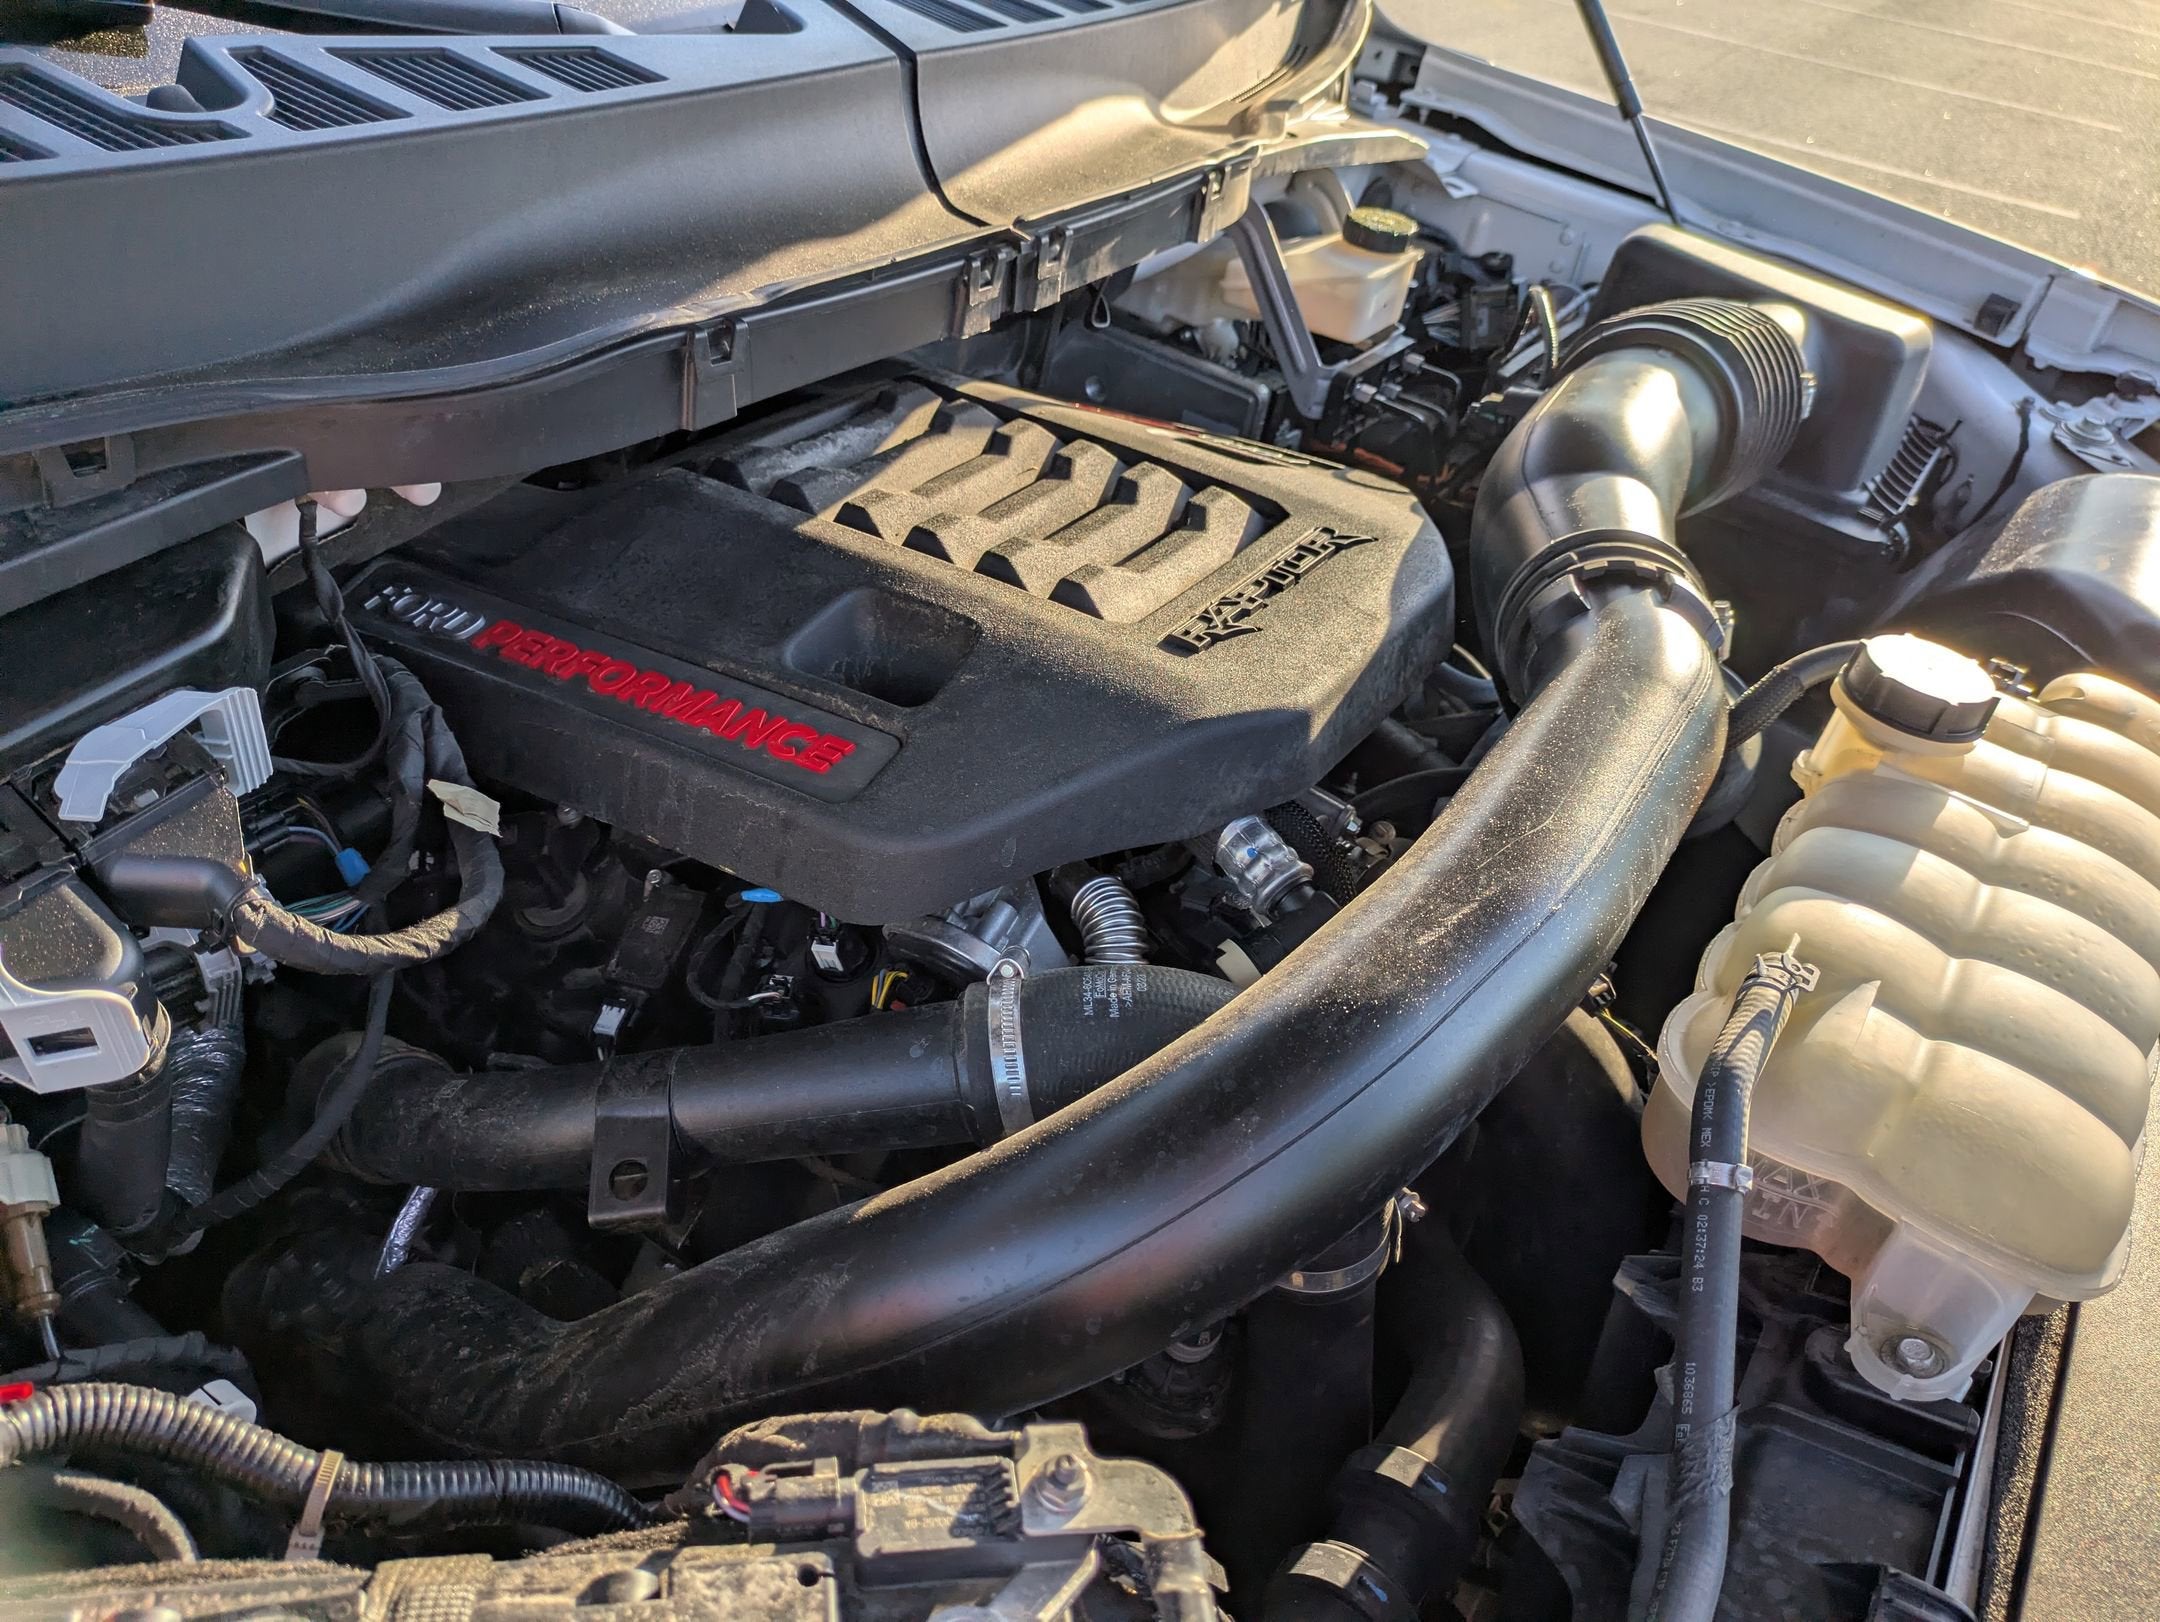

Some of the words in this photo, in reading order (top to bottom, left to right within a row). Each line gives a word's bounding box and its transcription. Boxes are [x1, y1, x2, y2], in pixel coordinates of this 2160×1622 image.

[1157, 527, 1379, 657] RAPTOR
[364, 586, 487, 641] FORD
[469, 619, 857, 775] PERFORMANCE
[1108, 992, 1120, 1018] Made
[1700, 1128, 1712, 1147] MEX
[1693, 1214, 1709, 1269] 02:37:24
[1681, 1361, 1697, 1415] 1036865
